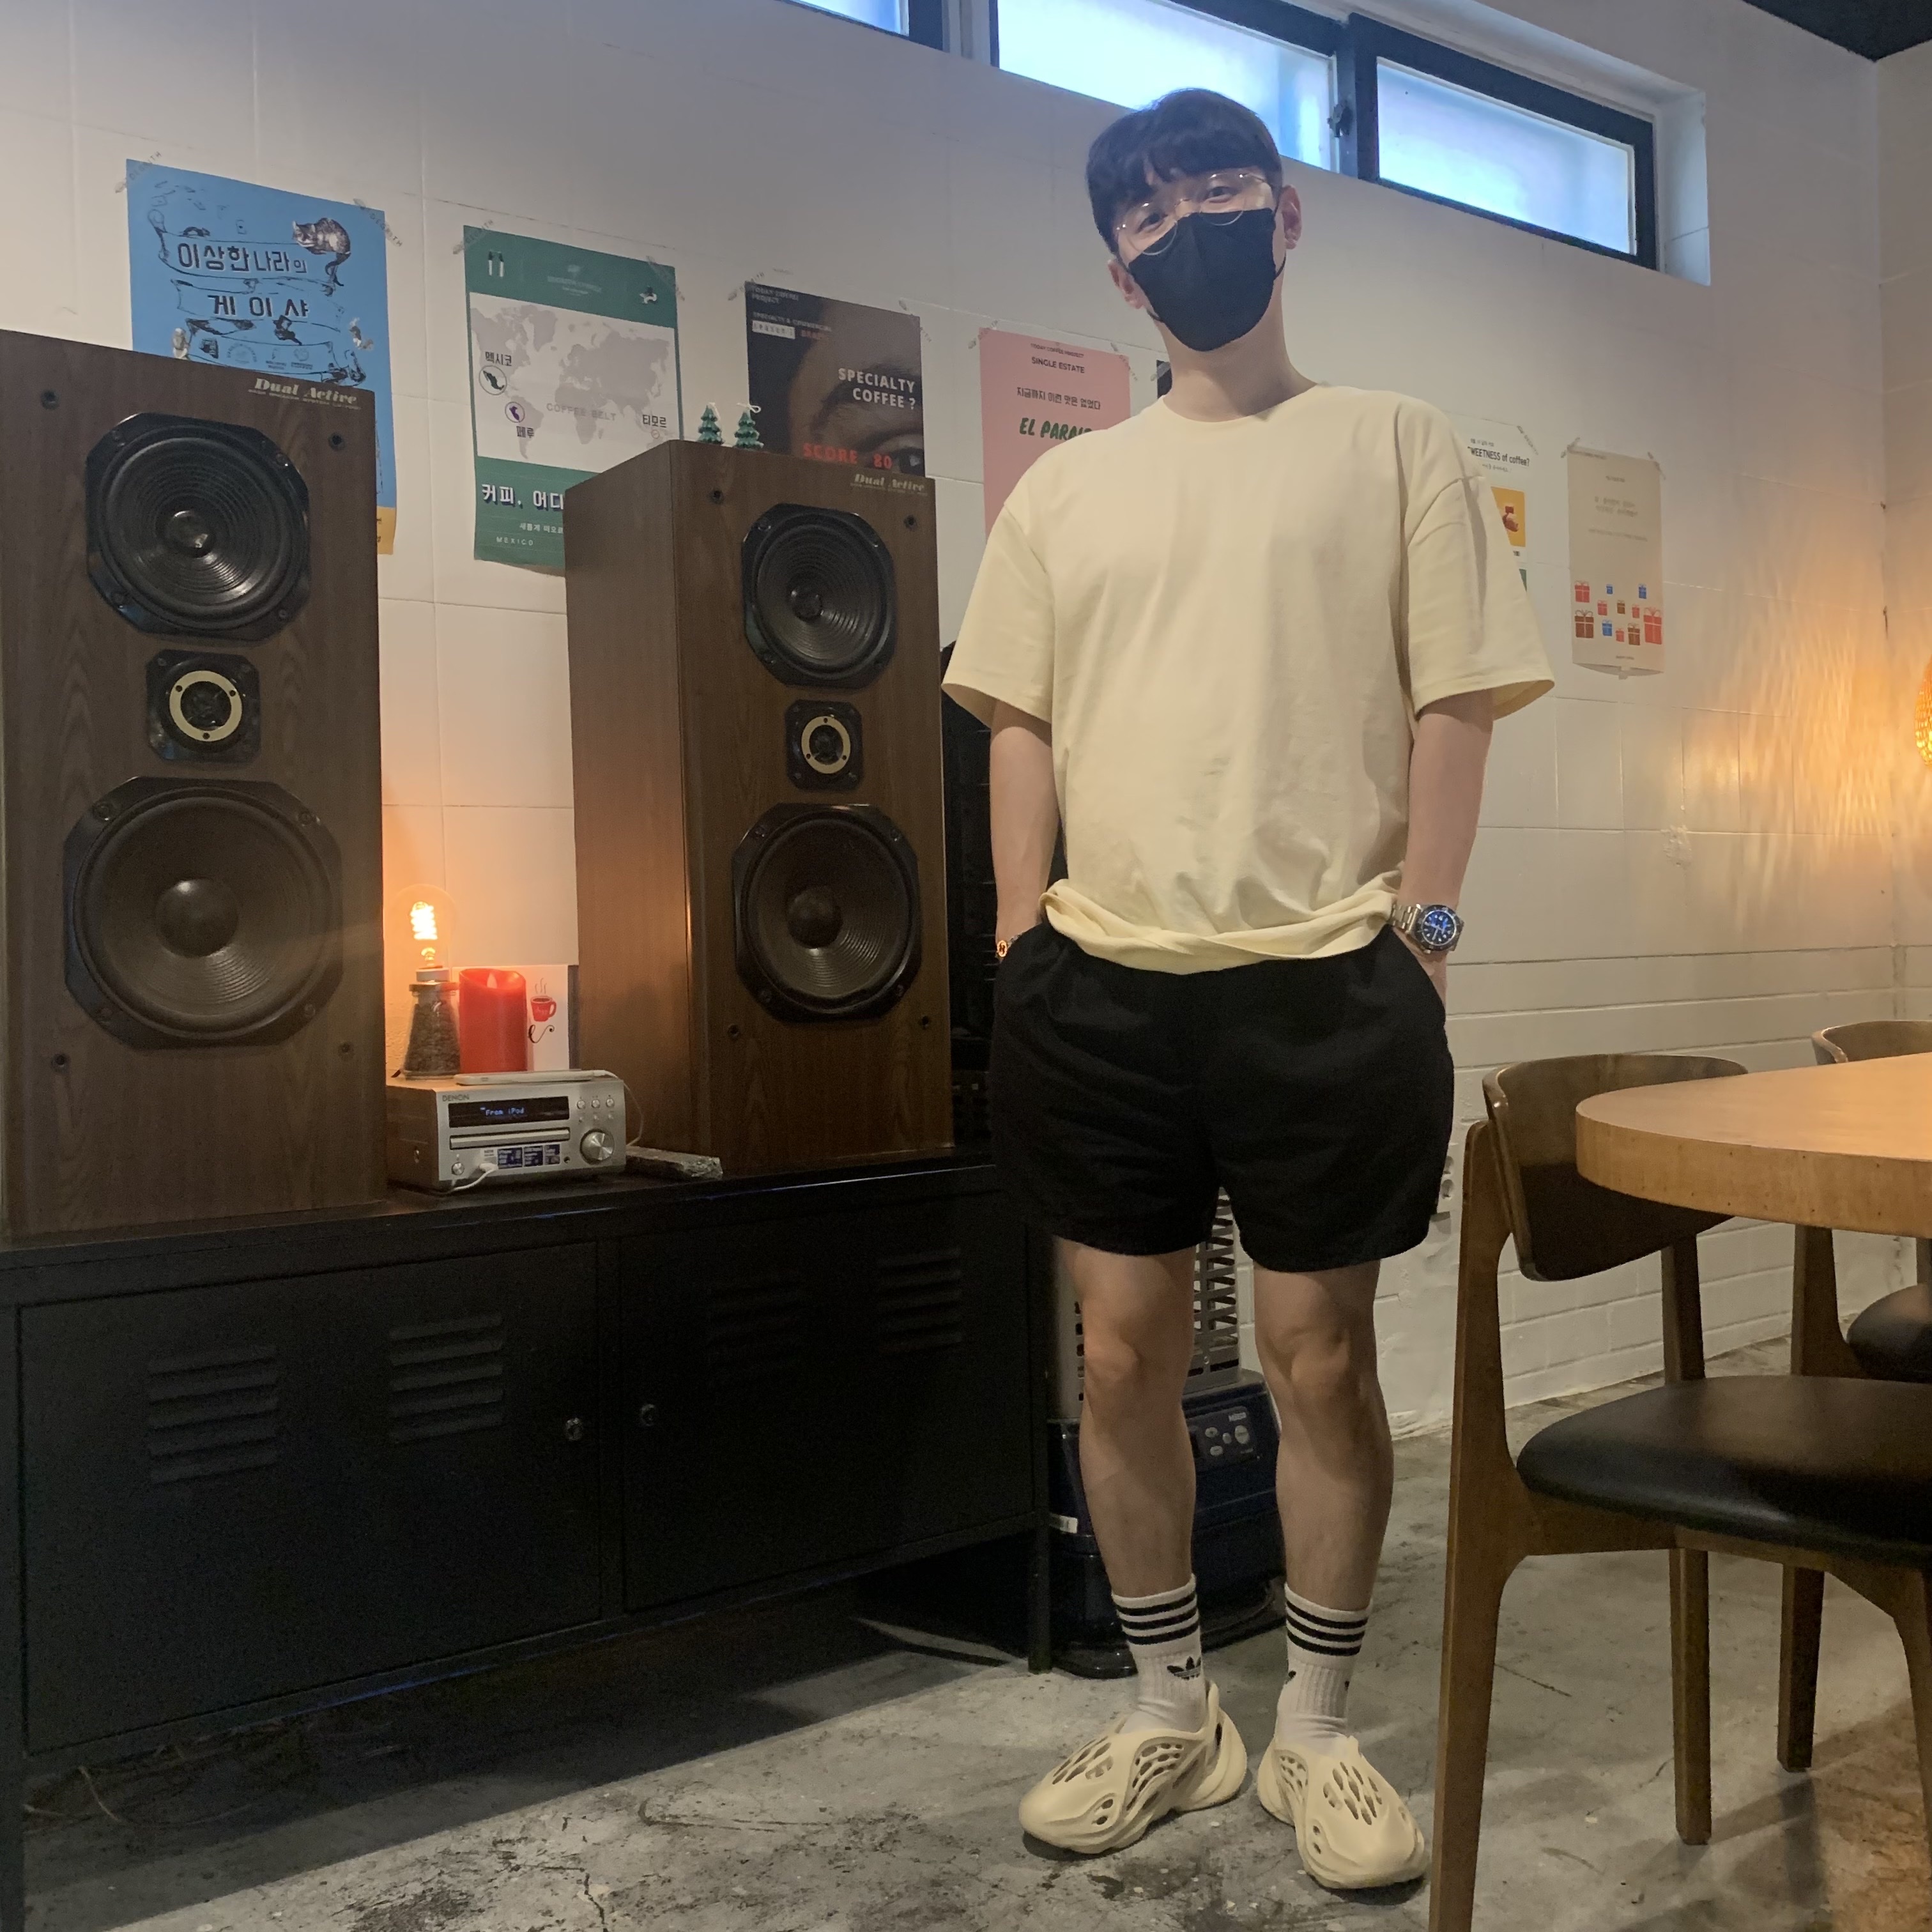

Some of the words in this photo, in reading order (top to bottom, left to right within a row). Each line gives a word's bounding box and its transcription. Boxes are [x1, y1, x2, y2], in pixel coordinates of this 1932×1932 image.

[485, 351, 512, 367] 멕시코
[1032, 356, 1057, 368] SINGLE
[1059, 362, 1085, 374] ESTATE
[838, 367, 916, 394] SPECIALTY
[255, 378, 300, 395] Dual
[303, 387, 357, 404] Active
[853, 388, 905, 408] COFFEE
[1017, 387, 1046, 401] 지금까지
[1048, 392, 1062, 404] 이런
[1064, 395, 1078, 407] 맛은
[1080, 398, 1101, 410] 없었다
[546, 403, 587, 417] COFFEE
[592, 410, 617, 421] BELT
[643, 415, 667, 428] 티모르
[1020, 417, 1036, 436] EL
[1040, 420, 1092, 441] PARAI
[516, 425, 535, 439] 페루
[803, 443, 857, 464] SCORE
[1501, 454, 1508, 462] of
[855, 473, 885, 486] Dual
[496, 537, 533, 546] MEXICO
